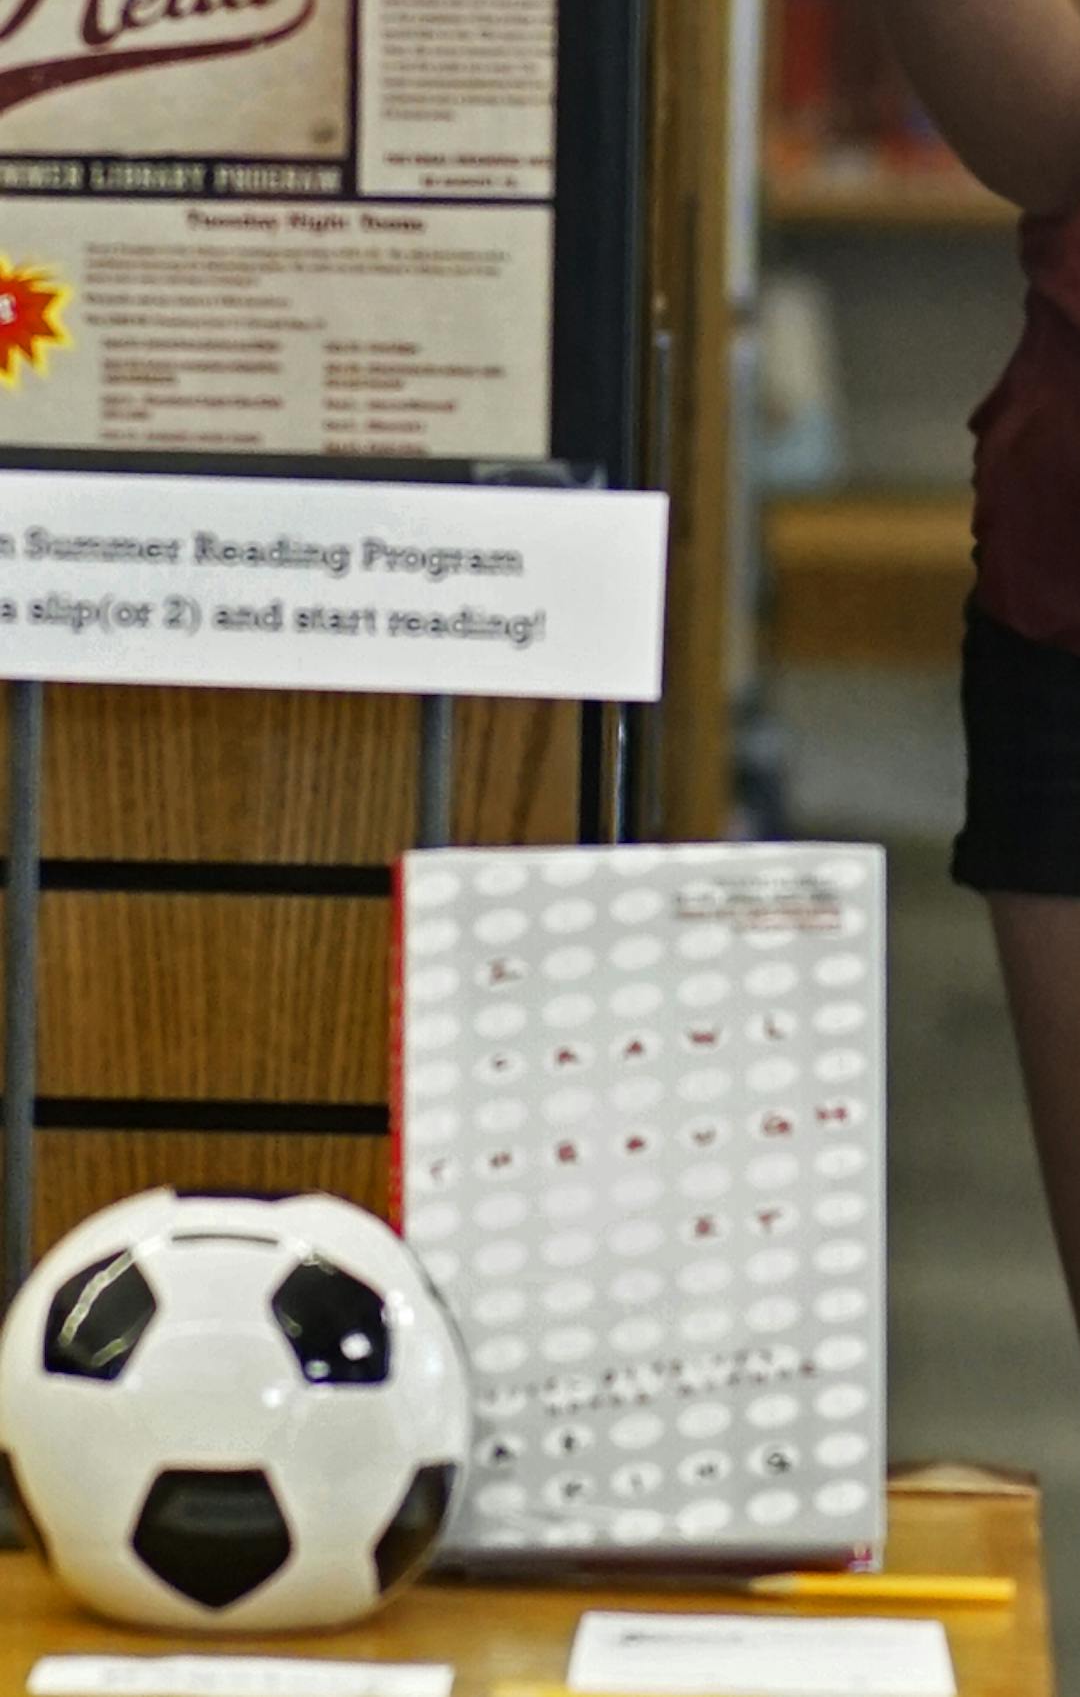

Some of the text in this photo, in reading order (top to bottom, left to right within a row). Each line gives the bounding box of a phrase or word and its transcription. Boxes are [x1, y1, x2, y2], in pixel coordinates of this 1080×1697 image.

[24, 525, 180, 563] Summer
[193, 529, 351, 579] Reading
[361, 535, 524, 583] Program
[212, 599, 284, 631] and
[294, 607, 377, 636] start
[387, 605, 547, 650] reading!
